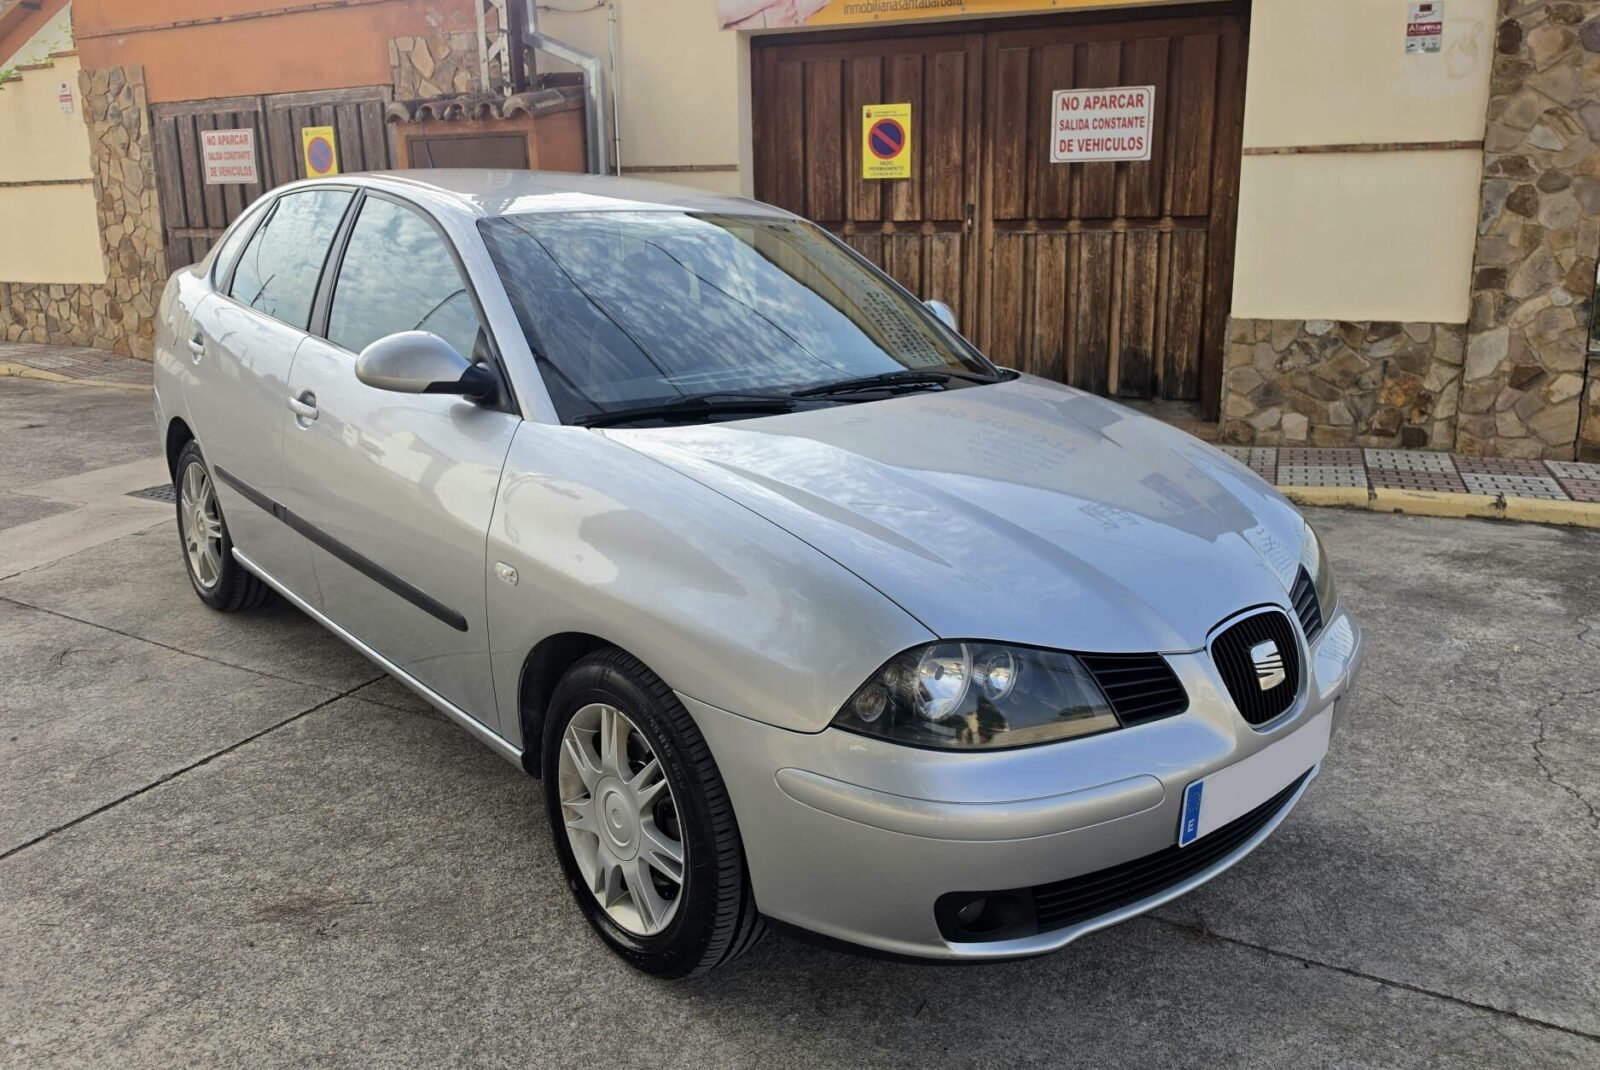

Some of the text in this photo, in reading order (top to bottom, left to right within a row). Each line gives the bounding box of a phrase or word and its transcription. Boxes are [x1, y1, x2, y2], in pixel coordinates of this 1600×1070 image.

[1061, 93, 1145, 111] NO APARCAR
[1059, 116, 1145, 131] SALIDA CONSTANTE
[206, 134, 249, 146] NO APARCAR
[1059, 136, 1144, 153] DE VEHICULOS
[210, 165, 253, 177] DE VEHICULOS
